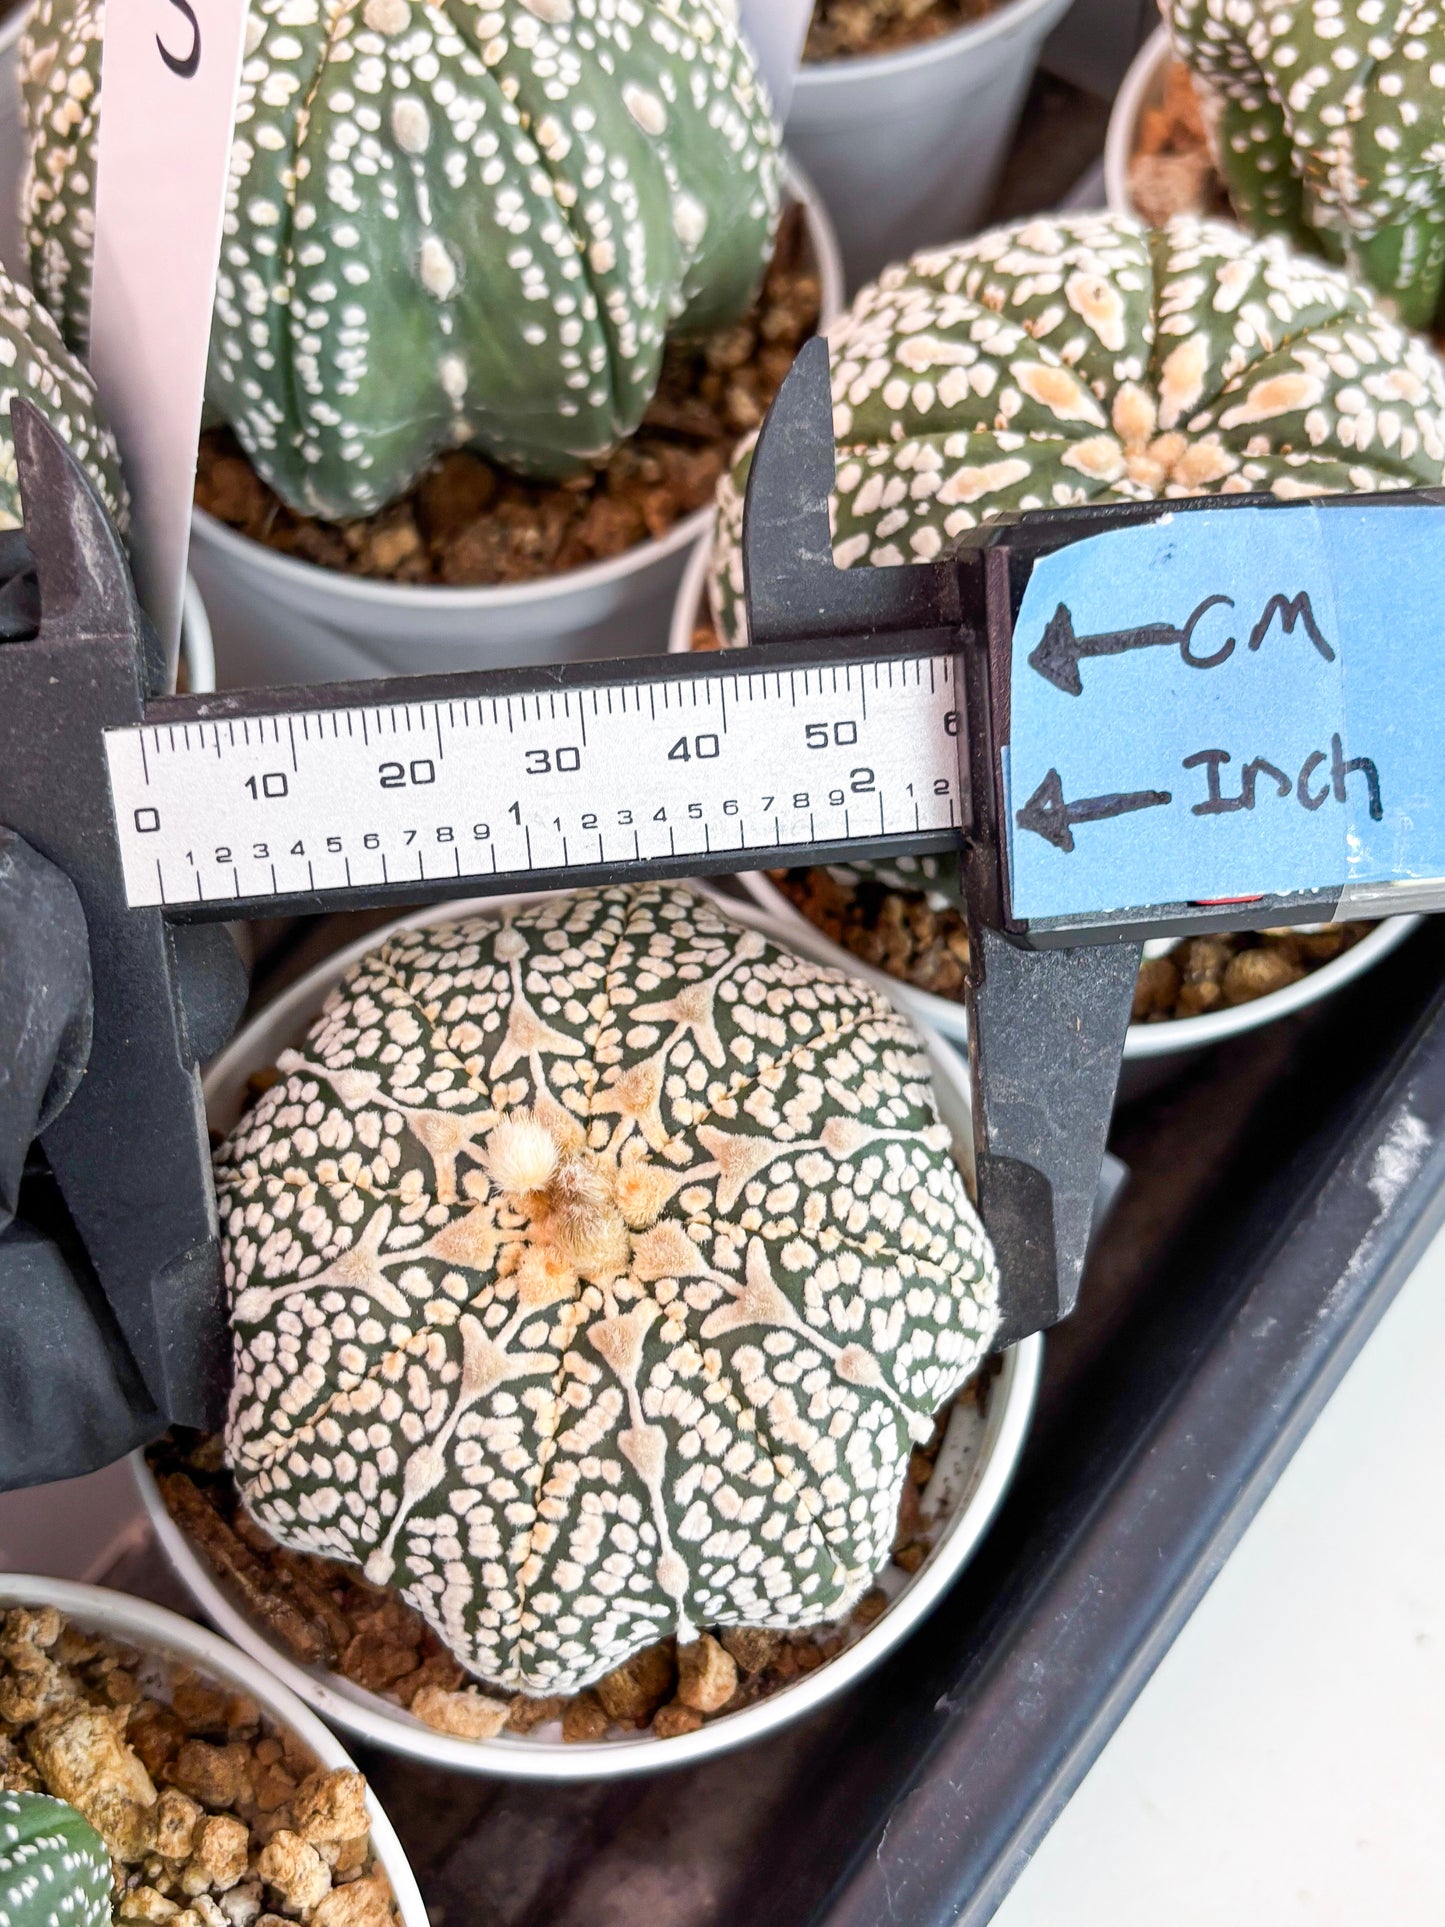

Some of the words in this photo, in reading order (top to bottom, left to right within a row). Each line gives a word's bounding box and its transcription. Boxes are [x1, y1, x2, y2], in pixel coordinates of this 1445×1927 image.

[1180, 591, 1335, 669] CM
[134, 807, 161, 833] 0
[244, 772, 289, 800] 10
[378, 759, 436, 789] 20
[525, 747, 581, 775] 30
[667, 733, 720, 763] 40
[805, 720, 858, 749] 50
[186, 850, 194, 866] 1
[215, 847, 233, 863] 2
[252, 843, 270, 859] 3
[290, 840, 306, 856] 4
[326, 836, 342, 853] 5
[363, 833, 380, 849] 6
[404, 829, 417, 846] 7
[436, 826, 455, 842] 8
[473, 822, 490, 840] 9
[508, 800, 521, 826] 1
[552, 816, 562, 832] 1
[581, 813, 598, 829] 2
[617, 809, 634, 825] 3
[653, 806, 667, 822] 4
[688, 802, 703, 819] 5
[722, 799, 739, 815] 6
[761, 796, 775, 812] 7
[793, 791, 810, 809] 8
[829, 790, 845, 806] 9
[849, 767, 876, 793] 2
[905, 782, 914, 798] 1
[933, 778, 950, 796] 2
[1182, 732, 1383, 821] Inch
